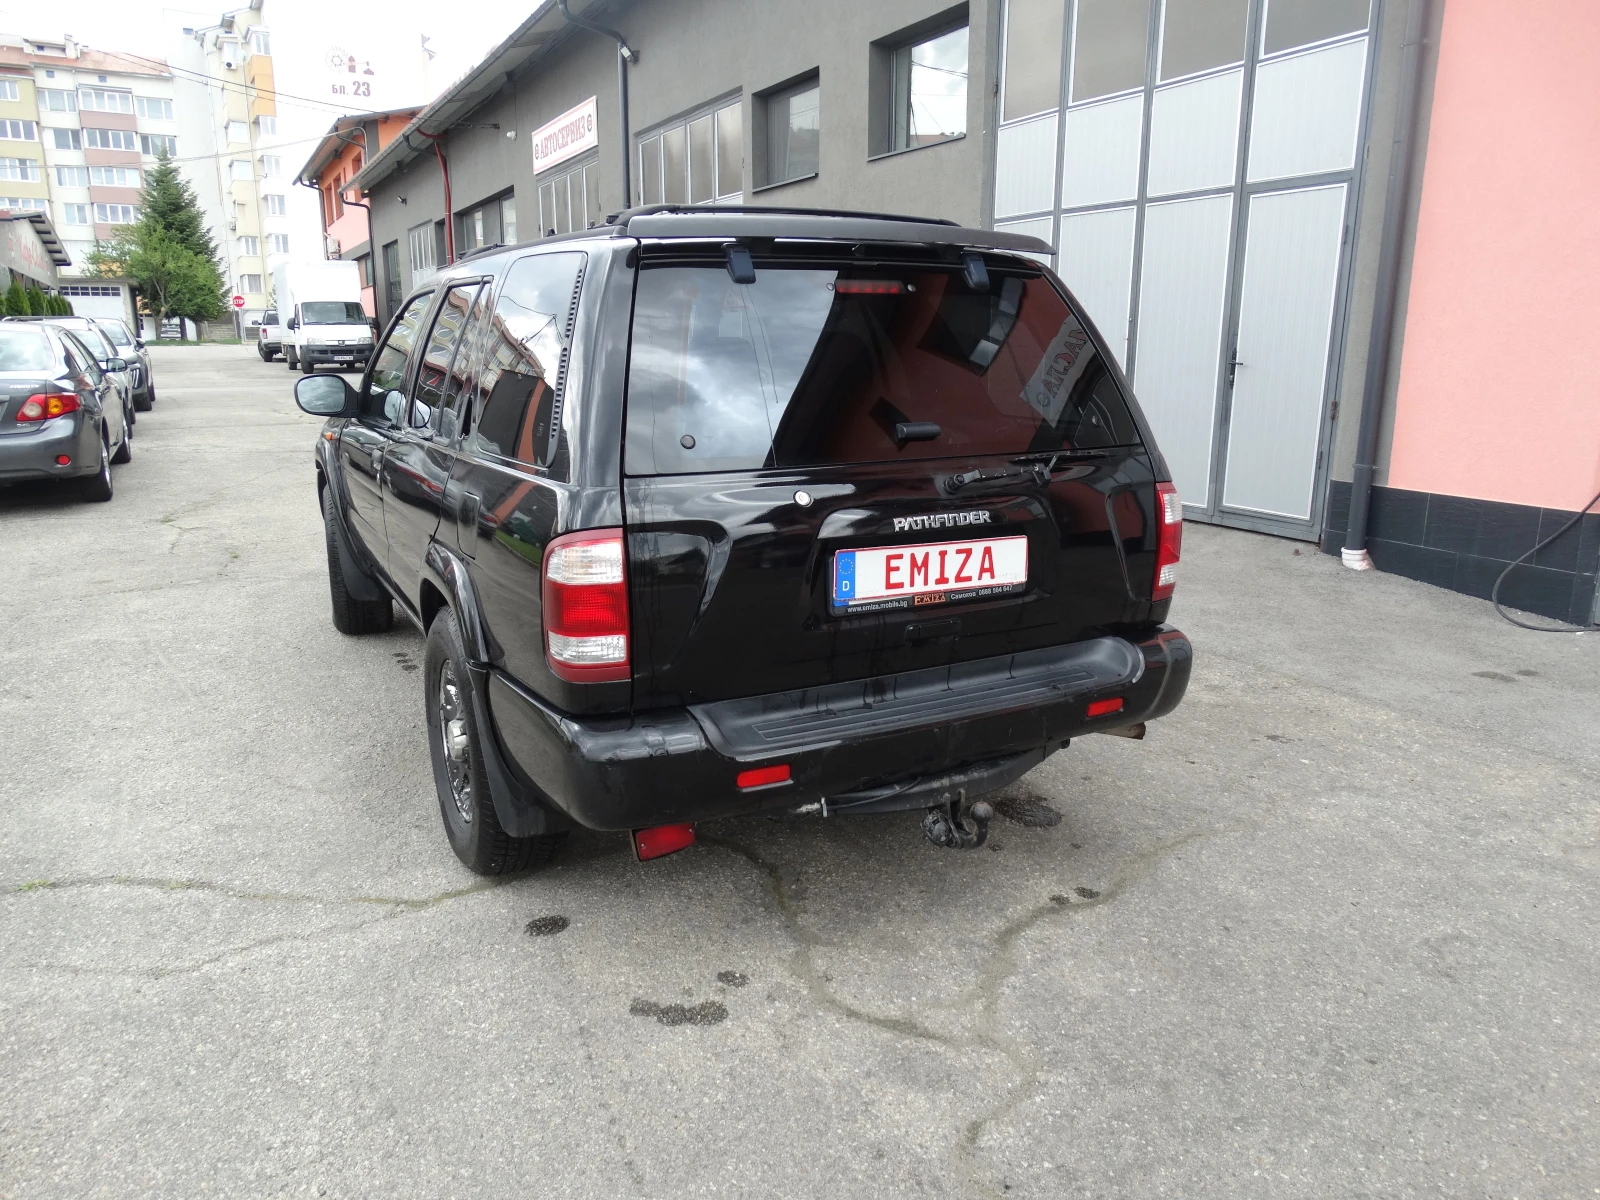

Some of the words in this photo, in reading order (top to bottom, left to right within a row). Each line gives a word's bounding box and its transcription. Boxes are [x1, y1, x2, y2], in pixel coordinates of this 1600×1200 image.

[352, 80, 371, 97] 23
[540, 115, 586, 160] АВТОСЕРВИЗ
[893, 510, 992, 533] PATHFINDER
[885, 545, 996, 590] EMIZA
[842, 580, 850, 591] D
